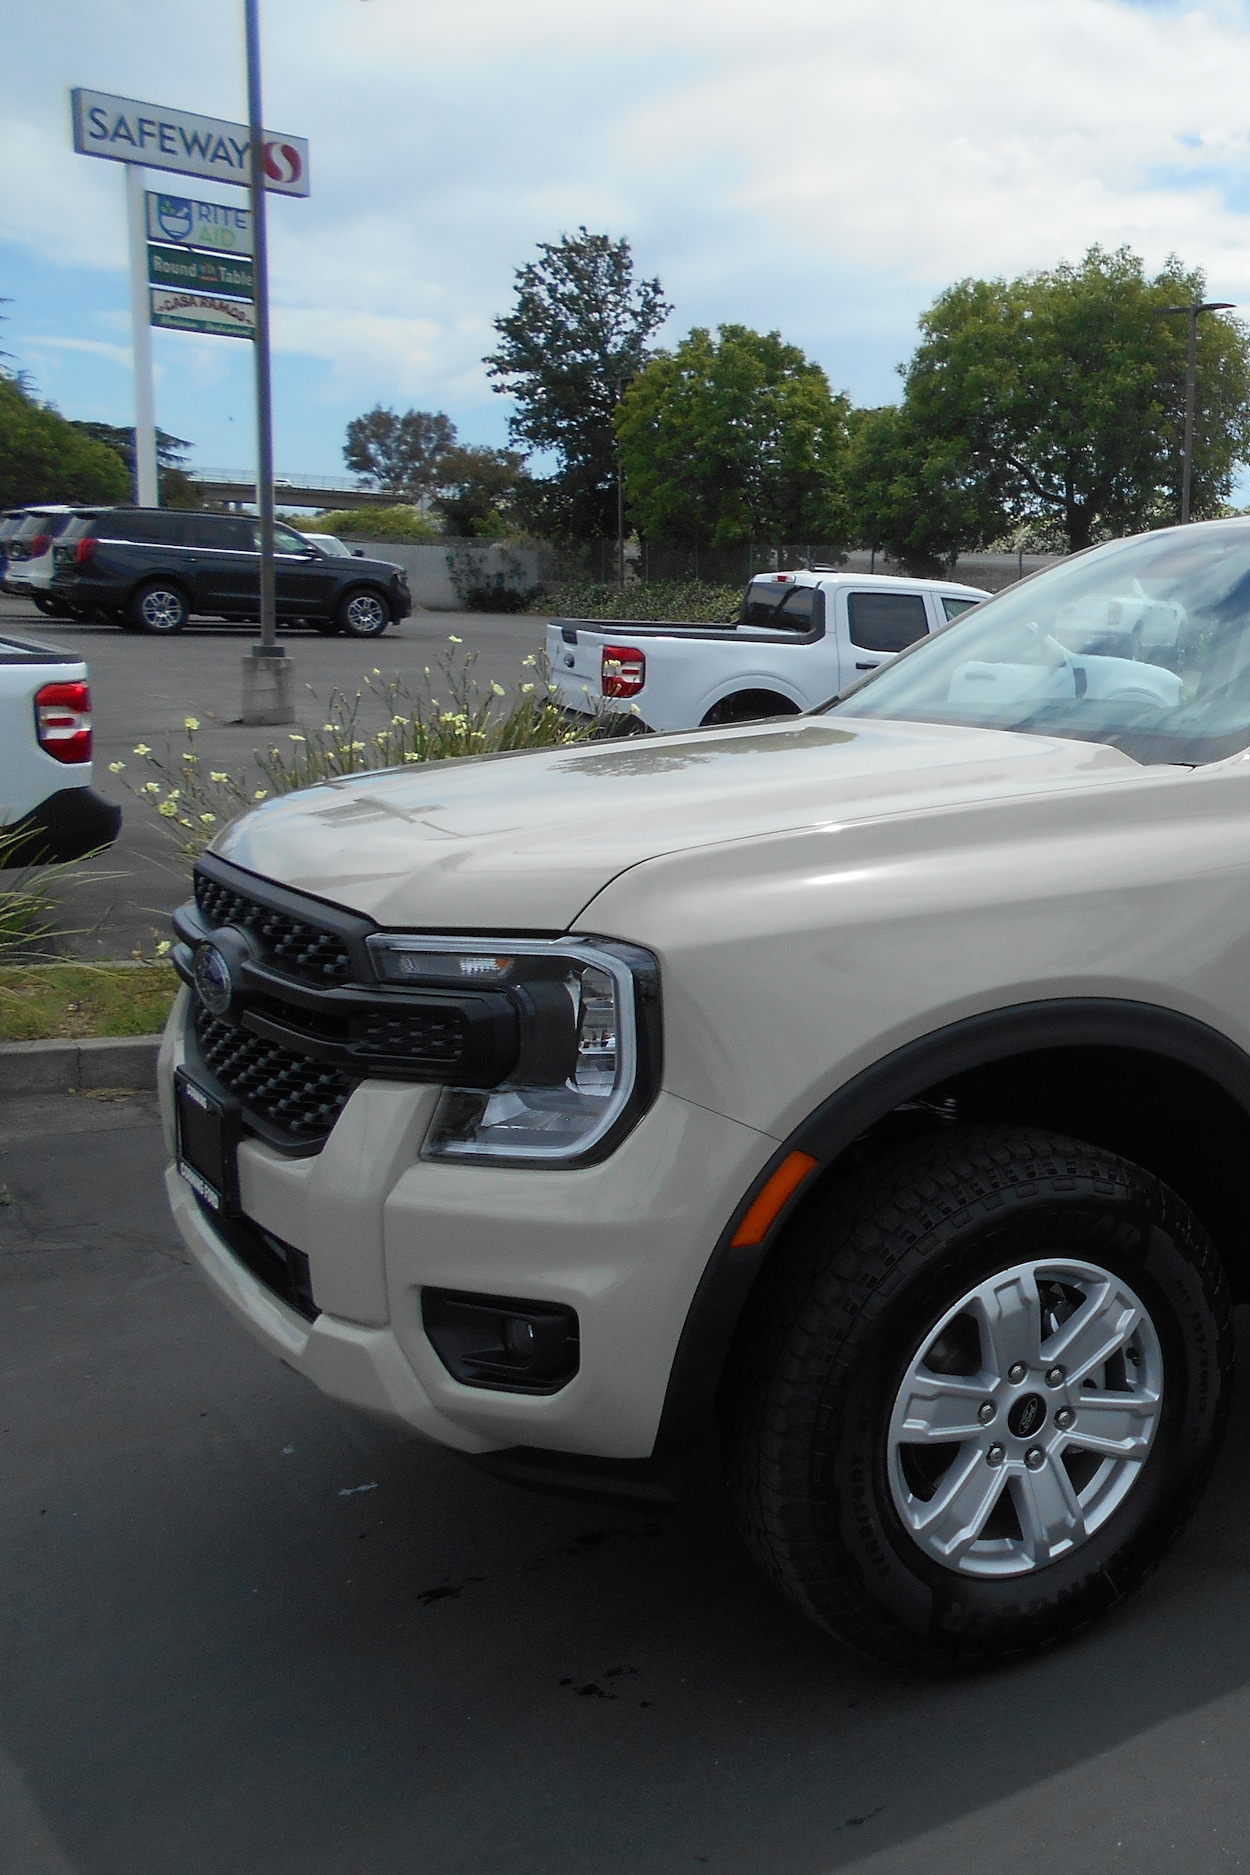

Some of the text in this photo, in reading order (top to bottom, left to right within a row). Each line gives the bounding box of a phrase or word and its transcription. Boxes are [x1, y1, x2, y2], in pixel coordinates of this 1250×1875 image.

[89, 107, 250, 170] SAFEWAY
[199, 203, 247, 229] RITE
[200, 228, 237, 248] AID
[153, 255, 253, 287] Round Table
[850, 1452, 893, 1578] TERRITORY
